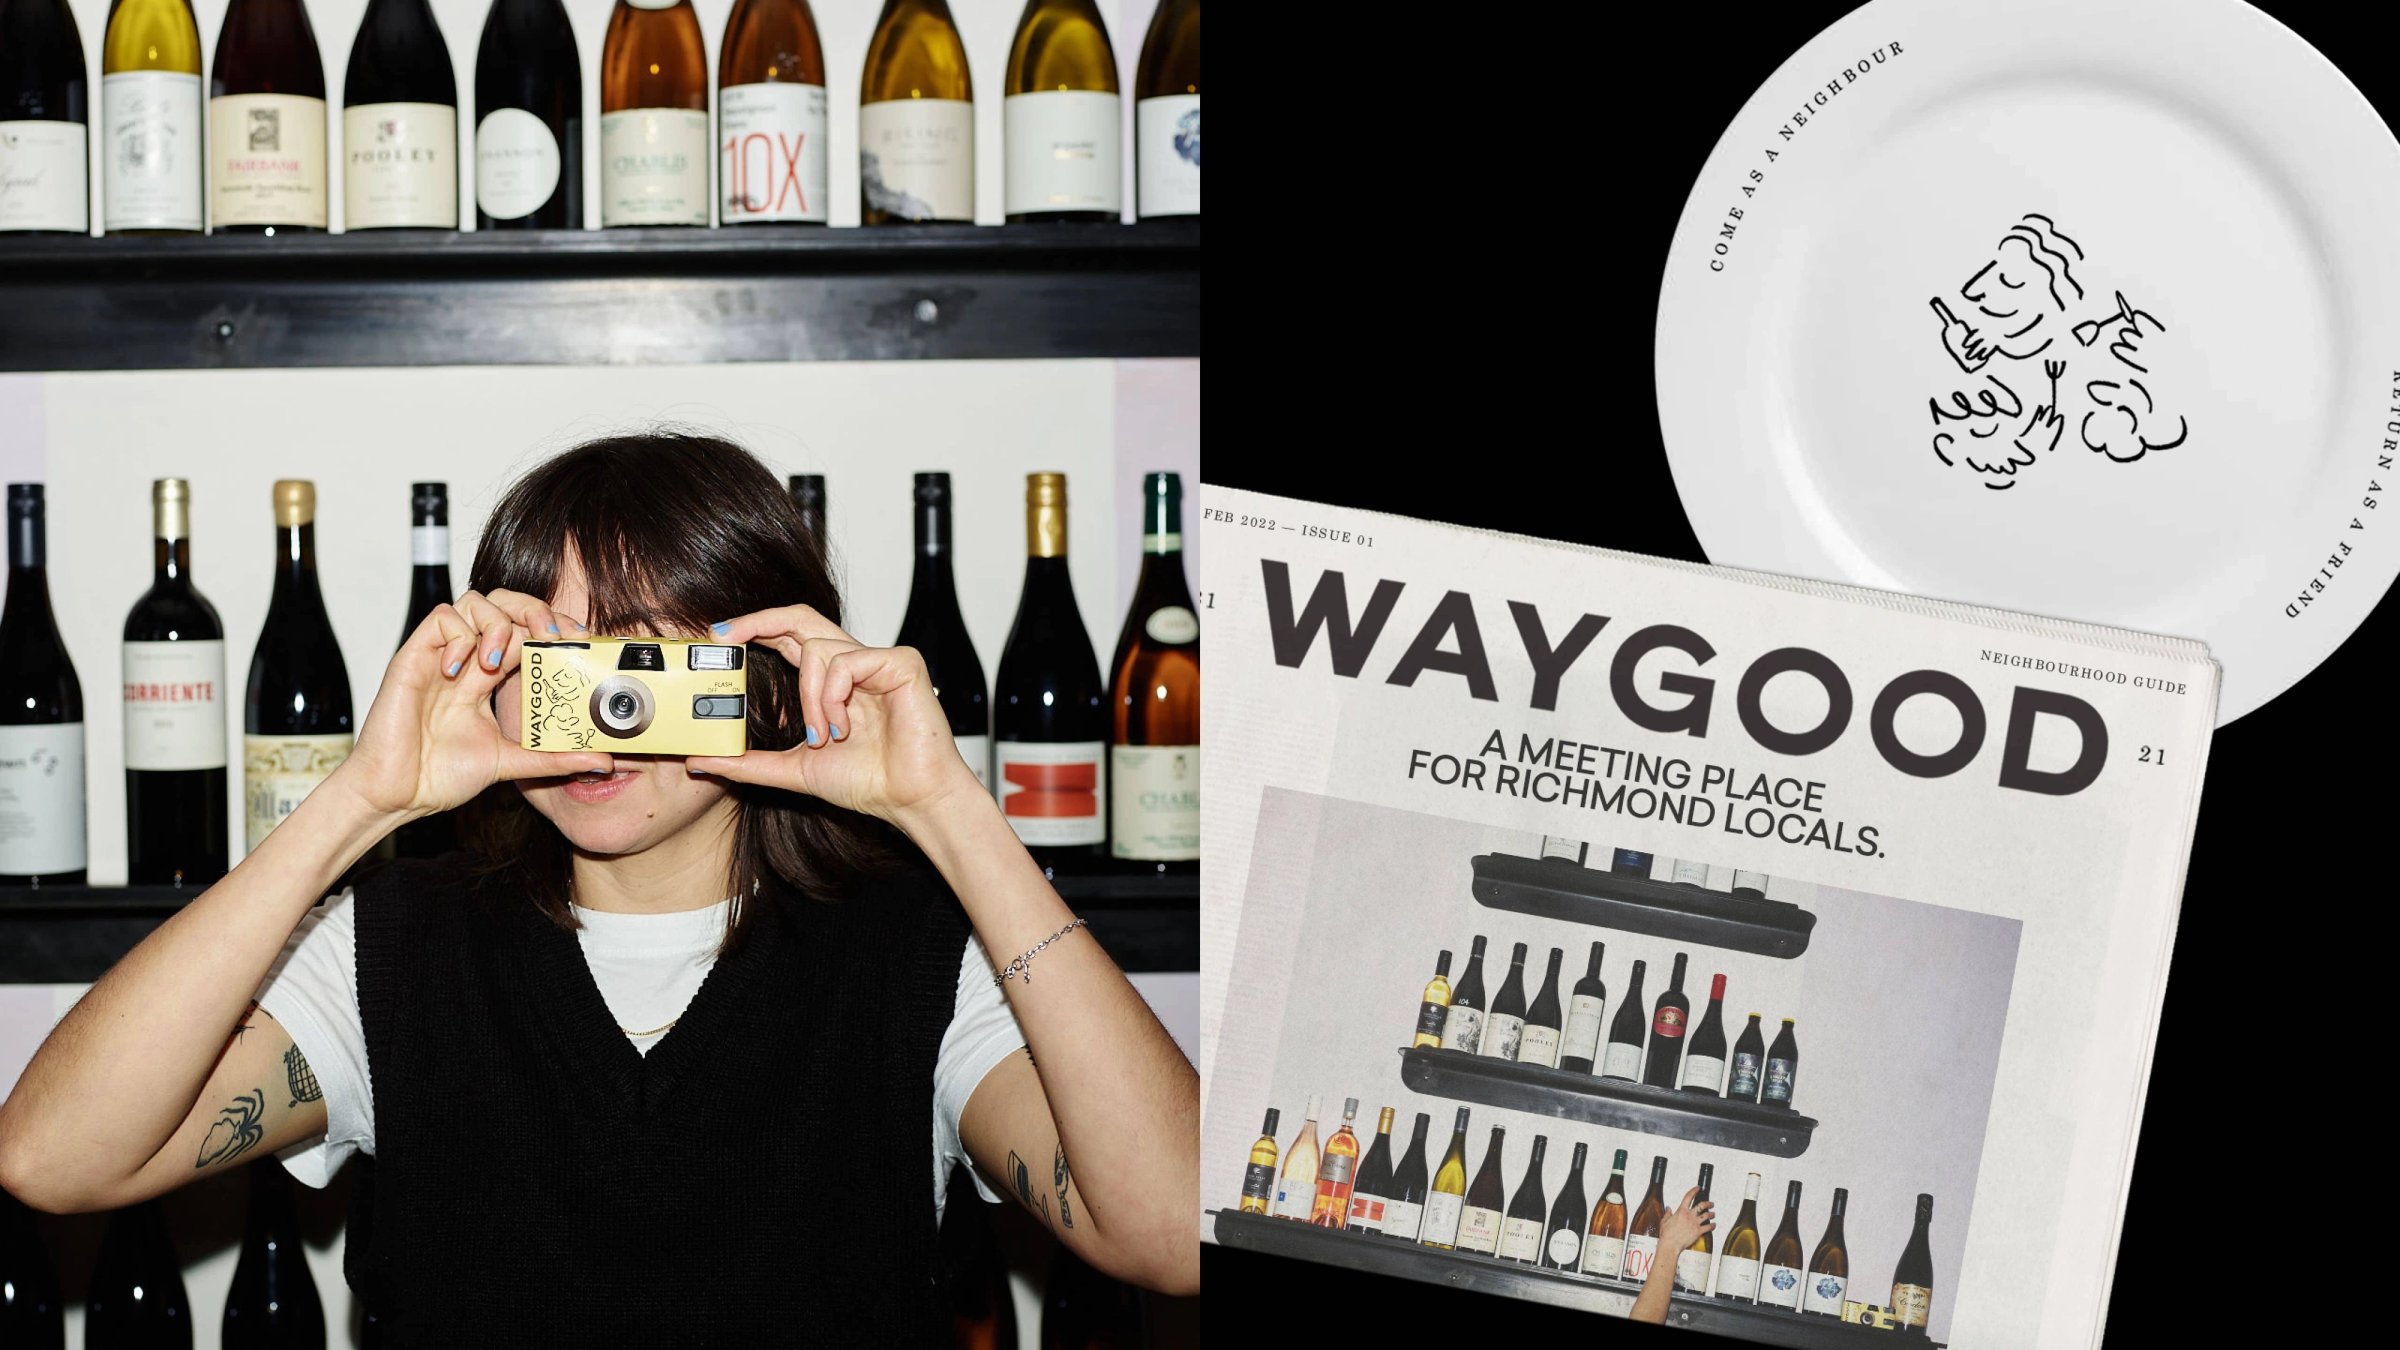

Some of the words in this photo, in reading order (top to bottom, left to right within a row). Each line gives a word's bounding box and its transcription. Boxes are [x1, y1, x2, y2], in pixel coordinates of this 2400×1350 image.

[351, 149, 435, 164] POOLEY
[721, 132, 808, 214] 10X
[1710, 206, 1744, 272] COME
[1741, 169, 1764, 199] AS
[1765, 149, 1779, 163] A
[1778, 41, 1905, 142] NEIGHBOUR
[2349, 517, 2364, 530] A
[2363, 479, 2383, 510] AS
[1203, 508, 1234, 523] FEB
[1240, 515, 1276, 531] 2022
[1302, 525, 1351, 544] ISSUE
[1357, 534, 1374, 548] 01
[1200, 591, 1215, 609] 1
[2285, 541, 2353, 619] FRIEND
[530, 652, 543, 748] WAYGOOD
[1260, 558, 2109, 796] WAYGOOD
[1980, 649, 2128, 686] NEIGHBOURHOOD
[2133, 676, 2188, 696] GUIDE
[1479, 729, 1507, 761] A
[1518, 733, 1691, 790] MEETING
[1701, 764, 1827, 813] PLACE
[2138, 745, 2166, 766] 21
[1407, 749, 1486, 791] FOR
[1495, 764, 1716, 829] RICHMOND
[1724, 802, 1886, 859] LOCALS.
